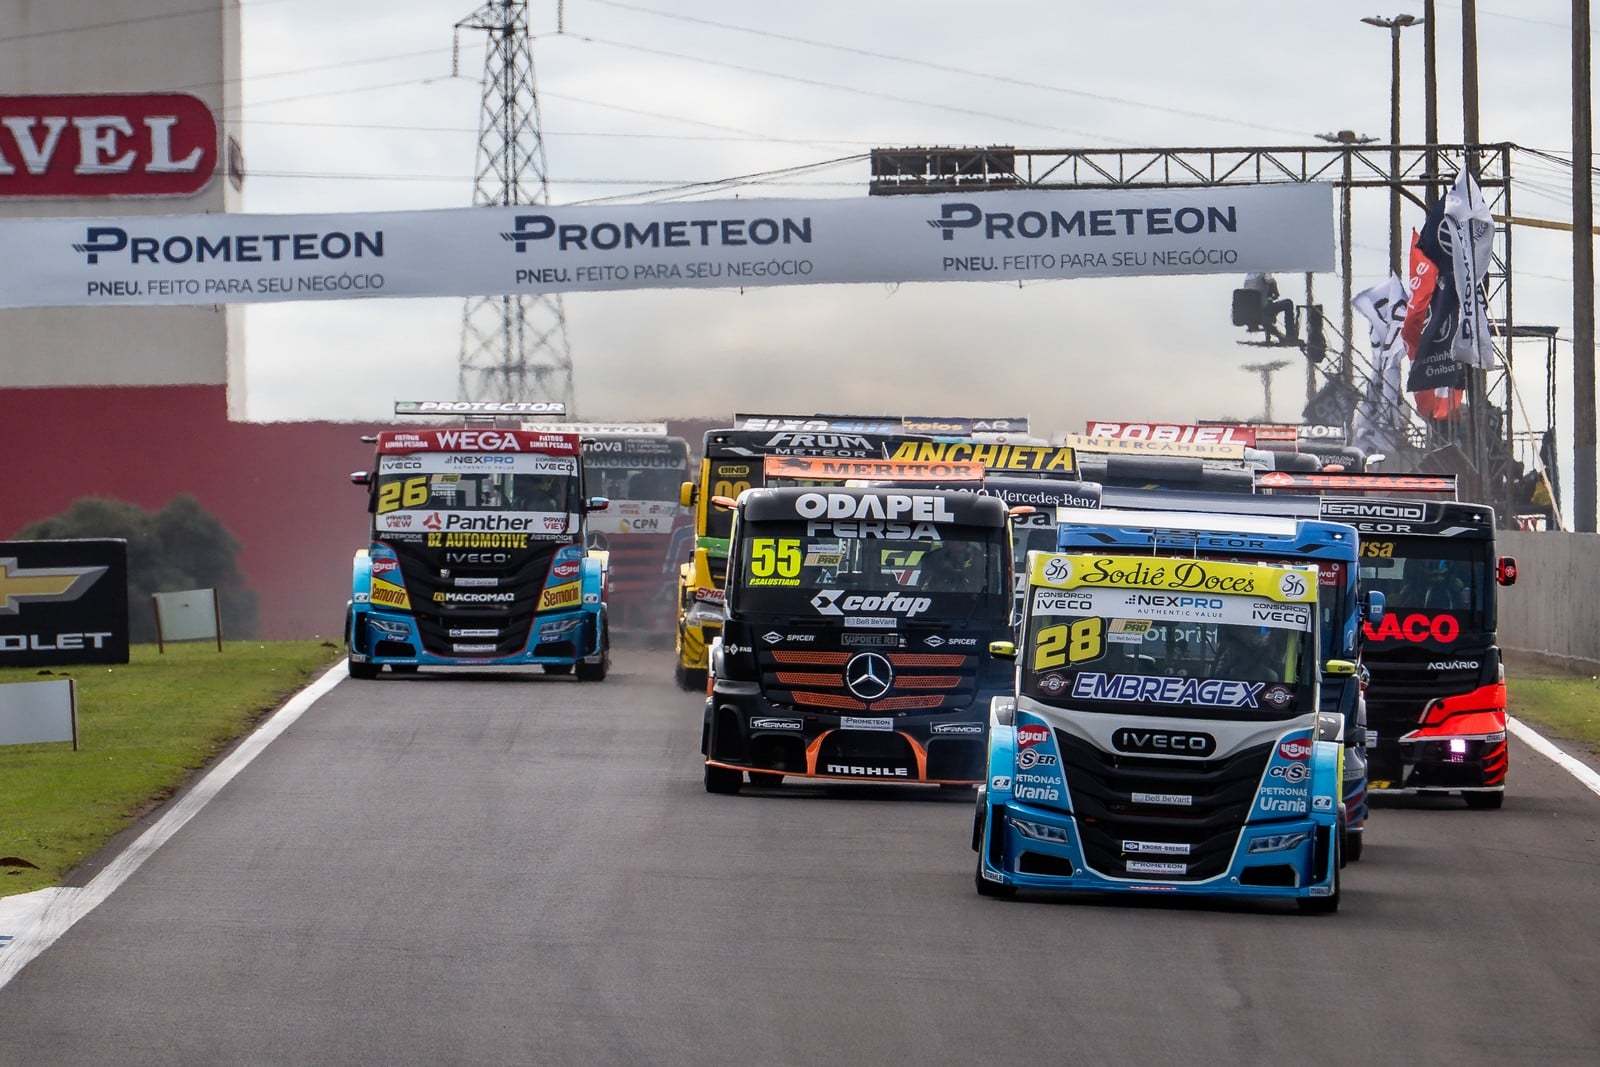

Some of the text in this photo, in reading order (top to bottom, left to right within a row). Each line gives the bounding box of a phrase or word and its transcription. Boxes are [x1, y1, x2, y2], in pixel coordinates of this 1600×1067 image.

[938, 203, 1237, 240] PROMETEON
[512, 214, 813, 252] PROMETEON
[85, 226, 384, 265] PROMETEON
[943, 246, 1238, 271] PNEU. FEITO PARA SEU NEGÓCIO
[516, 258, 813, 284] PNEU. FEITO PARA SEU NEGÓCIO
[87, 272, 384, 296] PNEU. FEITO PARA SEU NEGÓCIO
[419, 401, 564, 411] PROTECTOR
[436, 431, 521, 450] WEGA
[765, 432, 874, 449] FRUM
[1088, 423, 1247, 445] ROBIEL
[453, 456, 515, 464] NEXPRO
[776, 448, 866, 458] METEOR
[890, 442, 1073, 471] ANCHIETA
[382, 462, 422, 470] IVECO
[535, 462, 575, 471] IVECO
[823, 462, 972, 477] MERITOR
[1306, 474, 1446, 488] TEXACO
[377, 477, 428, 515] 26
[995, 489, 1097, 509] Mercedes-Benz
[795, 493, 954, 522] ODAPEL
[386, 520, 412, 528] VIEW
[446, 514, 533, 531] Panther
[633, 519, 658, 529] CPN
[807, 521, 941, 540] FERSA
[445, 533, 528, 548] AUTOMOTIVE
[446, 553, 507, 563] IVECO
[751, 539, 801, 577] 55
[1079, 558, 1254, 593] Sodiê Doces
[842, 591, 931, 617] cofap
[1037, 600, 1092, 610] IVECO
[1137, 594, 1223, 609] NEXPRO
[1253, 602, 1308, 613] CONSÓRCIO
[1137, 608, 1191, 616] AUTHENTIC
[1252, 610, 1307, 625] IVECO
[1123, 623, 1148, 632] PRO
[1034, 618, 1101, 671] 28
[1427, 660, 1479, 671] AQUÁRIO
[1071, 672, 1265, 709] EMBREAGEX
[1122, 731, 1207, 751] IVECO
[827, 764, 908, 776] MAHLE
[1015, 785, 1059, 801] Urania
[1261, 787, 1308, 797] PETRONAS
[1260, 797, 1306, 812] Urania
